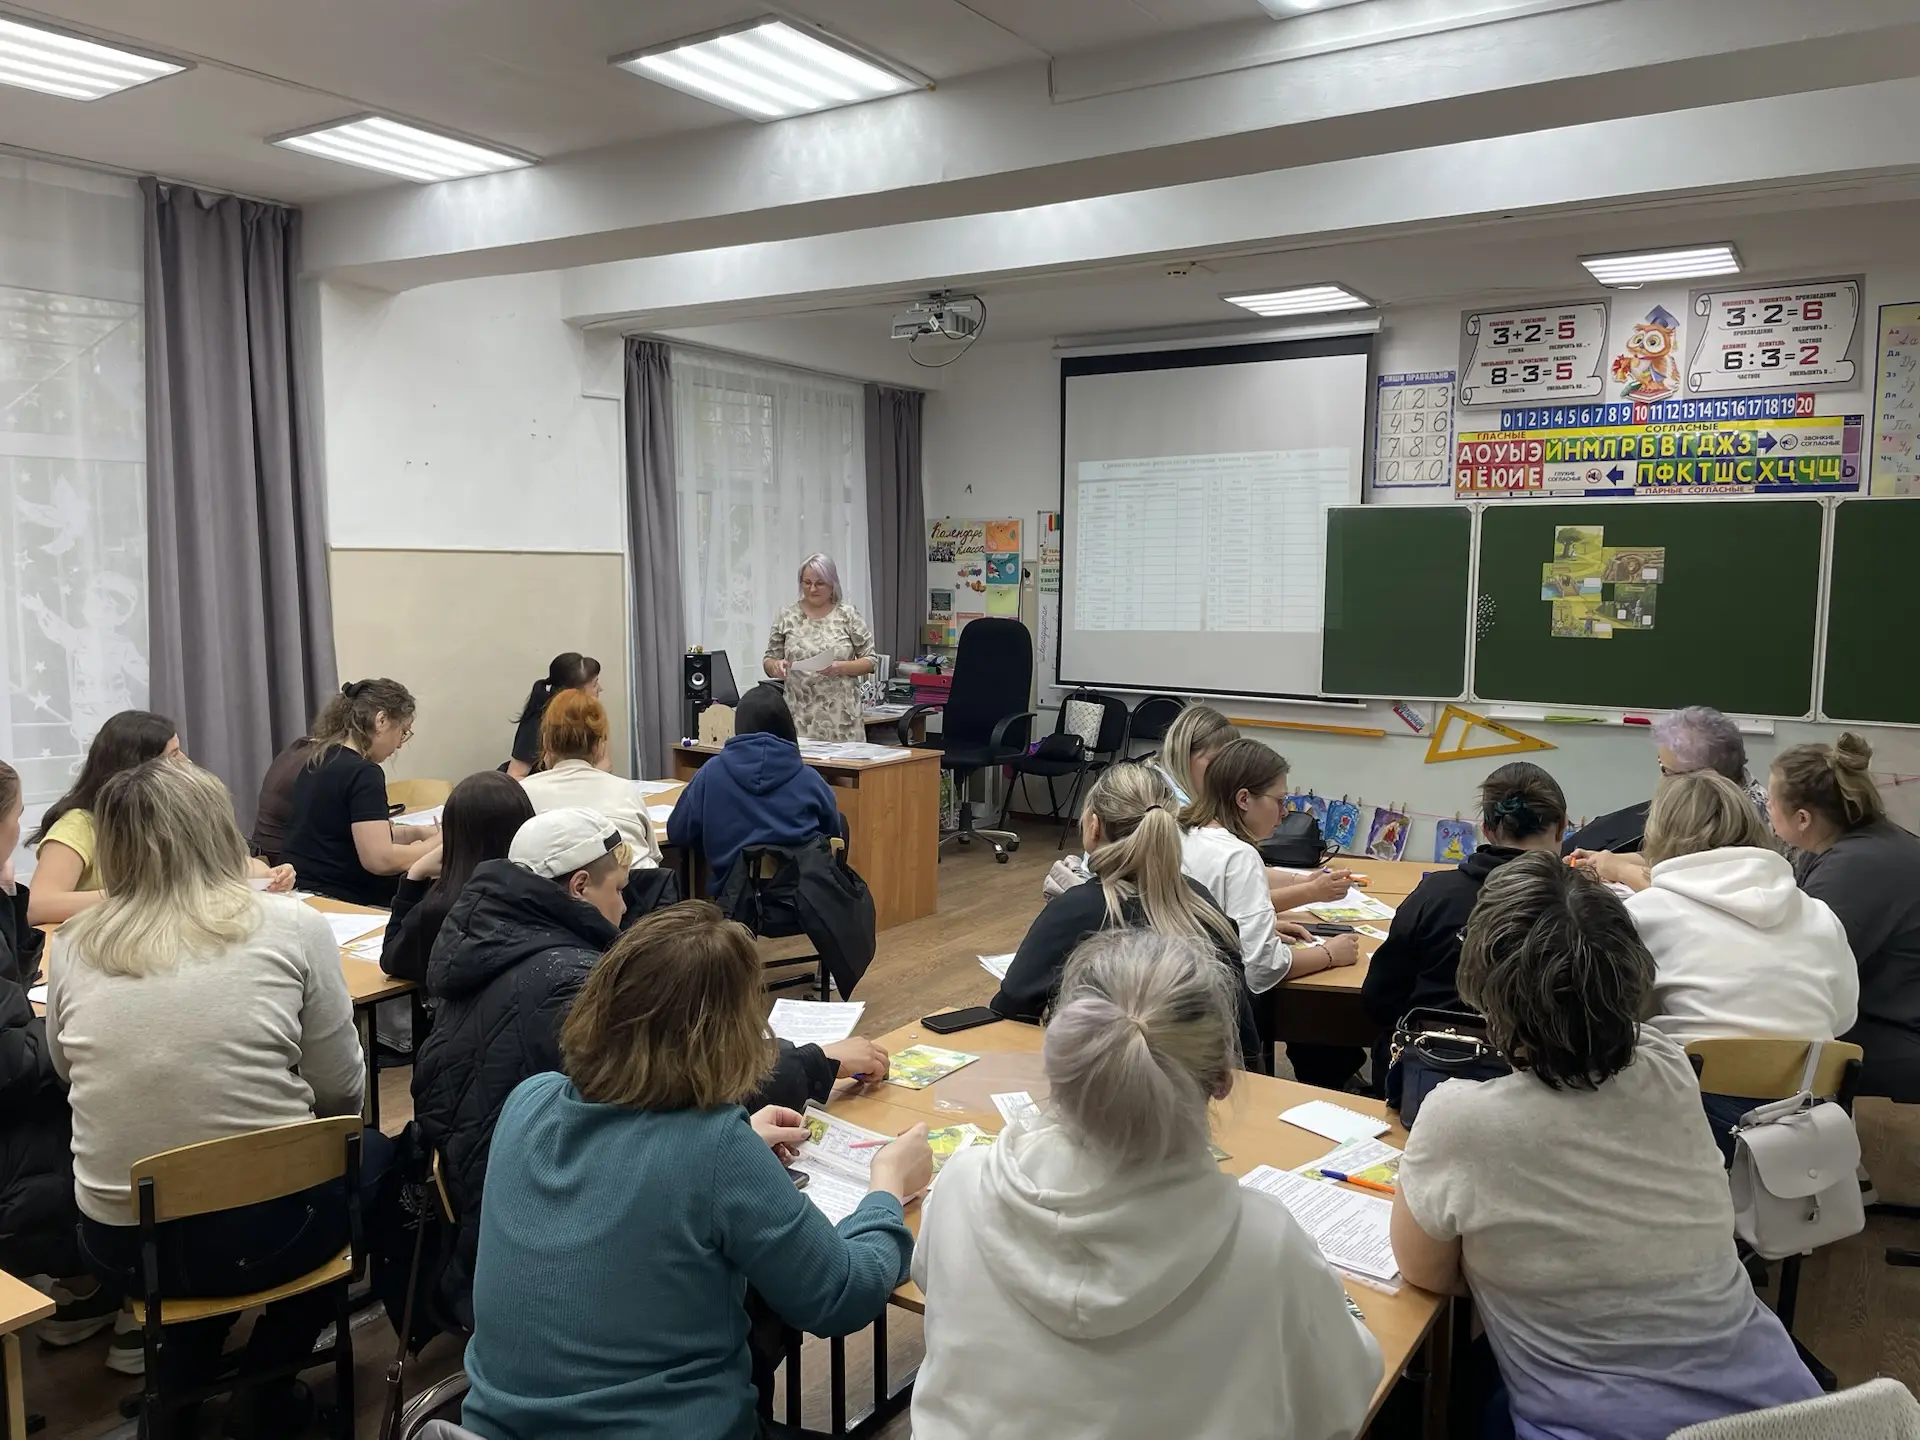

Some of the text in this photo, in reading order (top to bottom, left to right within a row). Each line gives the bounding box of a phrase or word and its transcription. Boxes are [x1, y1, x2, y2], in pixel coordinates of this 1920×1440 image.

[1758, 340, 1786, 348] ДЕЛИТЕЛЬ
[1406, 371, 1449, 381] ПРАВИЛЬНО
[1393, 386, 1448, 410] 1 2 3
[1390, 411, 1447, 434] 4 5 6
[1503, 397, 1812, 427] 0 1 2 3 4 5 6 7 8 9 10 11 12 13 14 15 16 17 18 19 20
[1477, 431, 1526, 440] ГЛАСНЫЕ
[1645, 422, 1719, 433] СОГЛАСНЫЕ
[1388, 435, 1447, 458] 7 8 9
[1386, 461, 1399, 481] 0
[931, 522, 983, 545] Календарь
